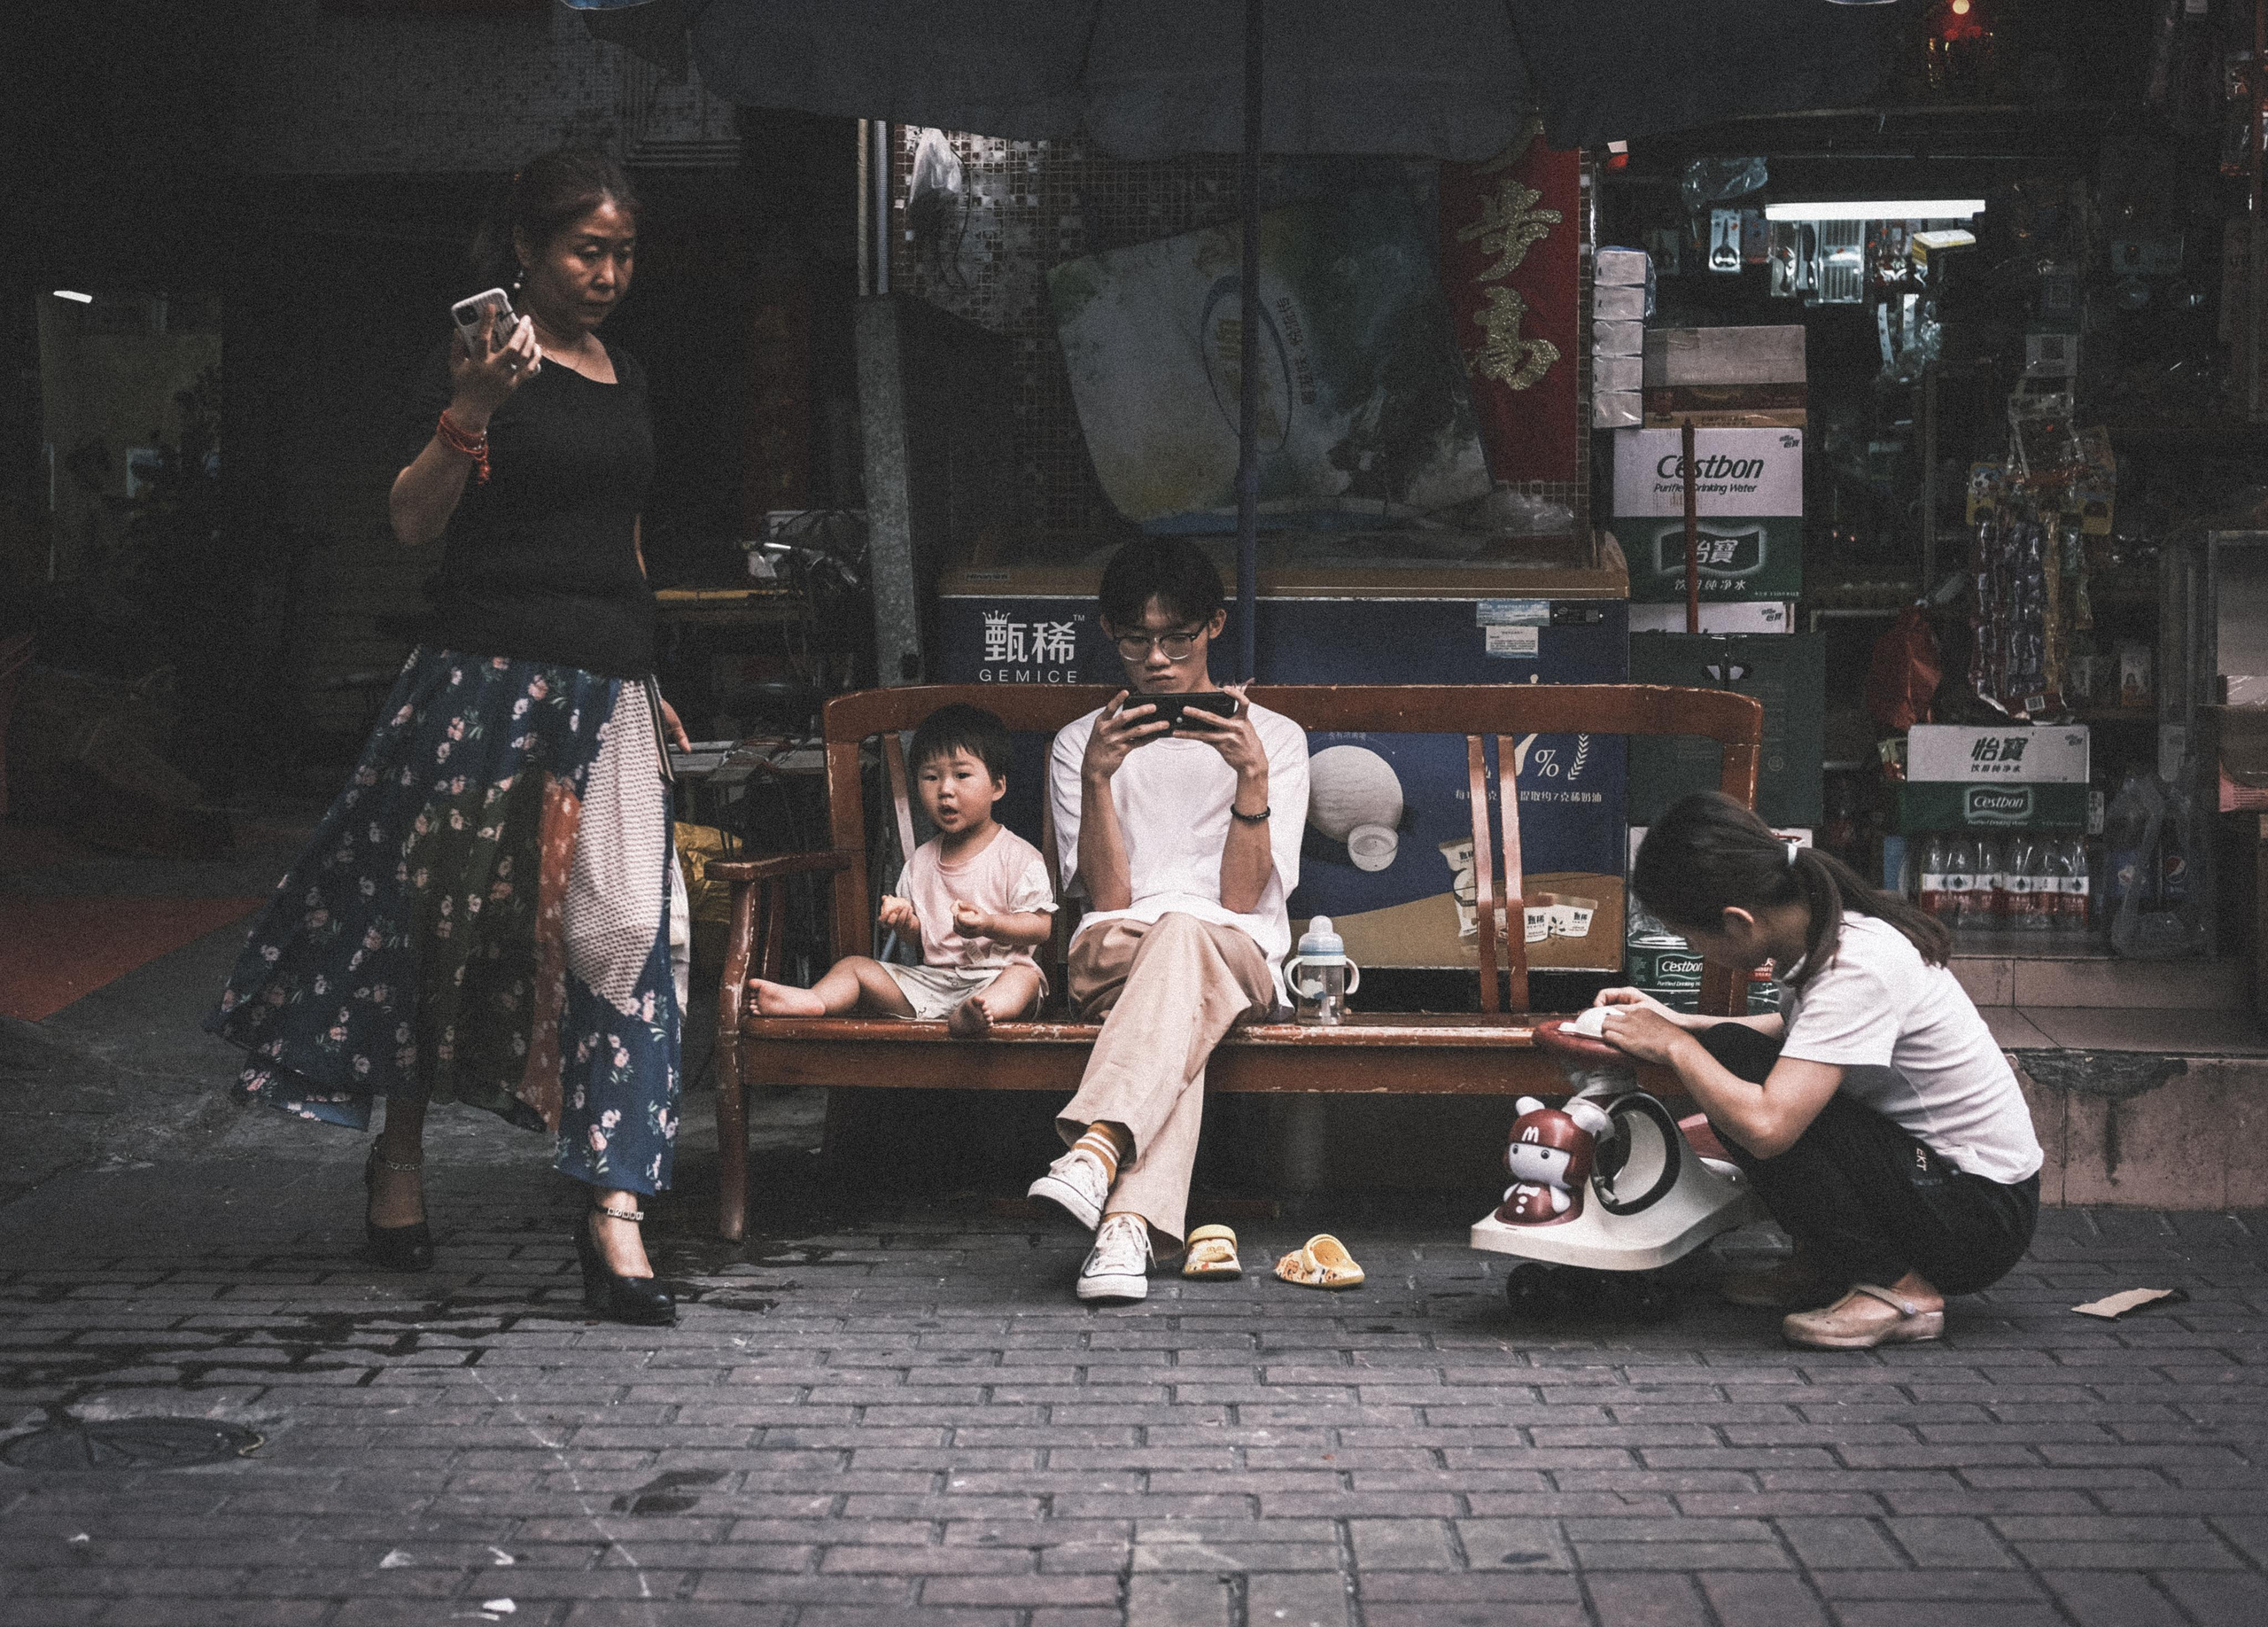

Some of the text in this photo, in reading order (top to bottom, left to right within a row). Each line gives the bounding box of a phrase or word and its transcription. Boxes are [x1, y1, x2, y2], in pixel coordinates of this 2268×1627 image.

[1456, 117, 1563, 392] 步高
[1653, 483, 1684, 494] Purifie
[1729, 483, 1758, 494] Water
[983, 620, 1076, 664] 甄稀
[979, 669, 1077, 683] GEMICE
[1970, 736, 2030, 761] 怡寶
[1521, 1126, 1540, 1143] M
[1915, 1148, 1928, 1172] EKT
